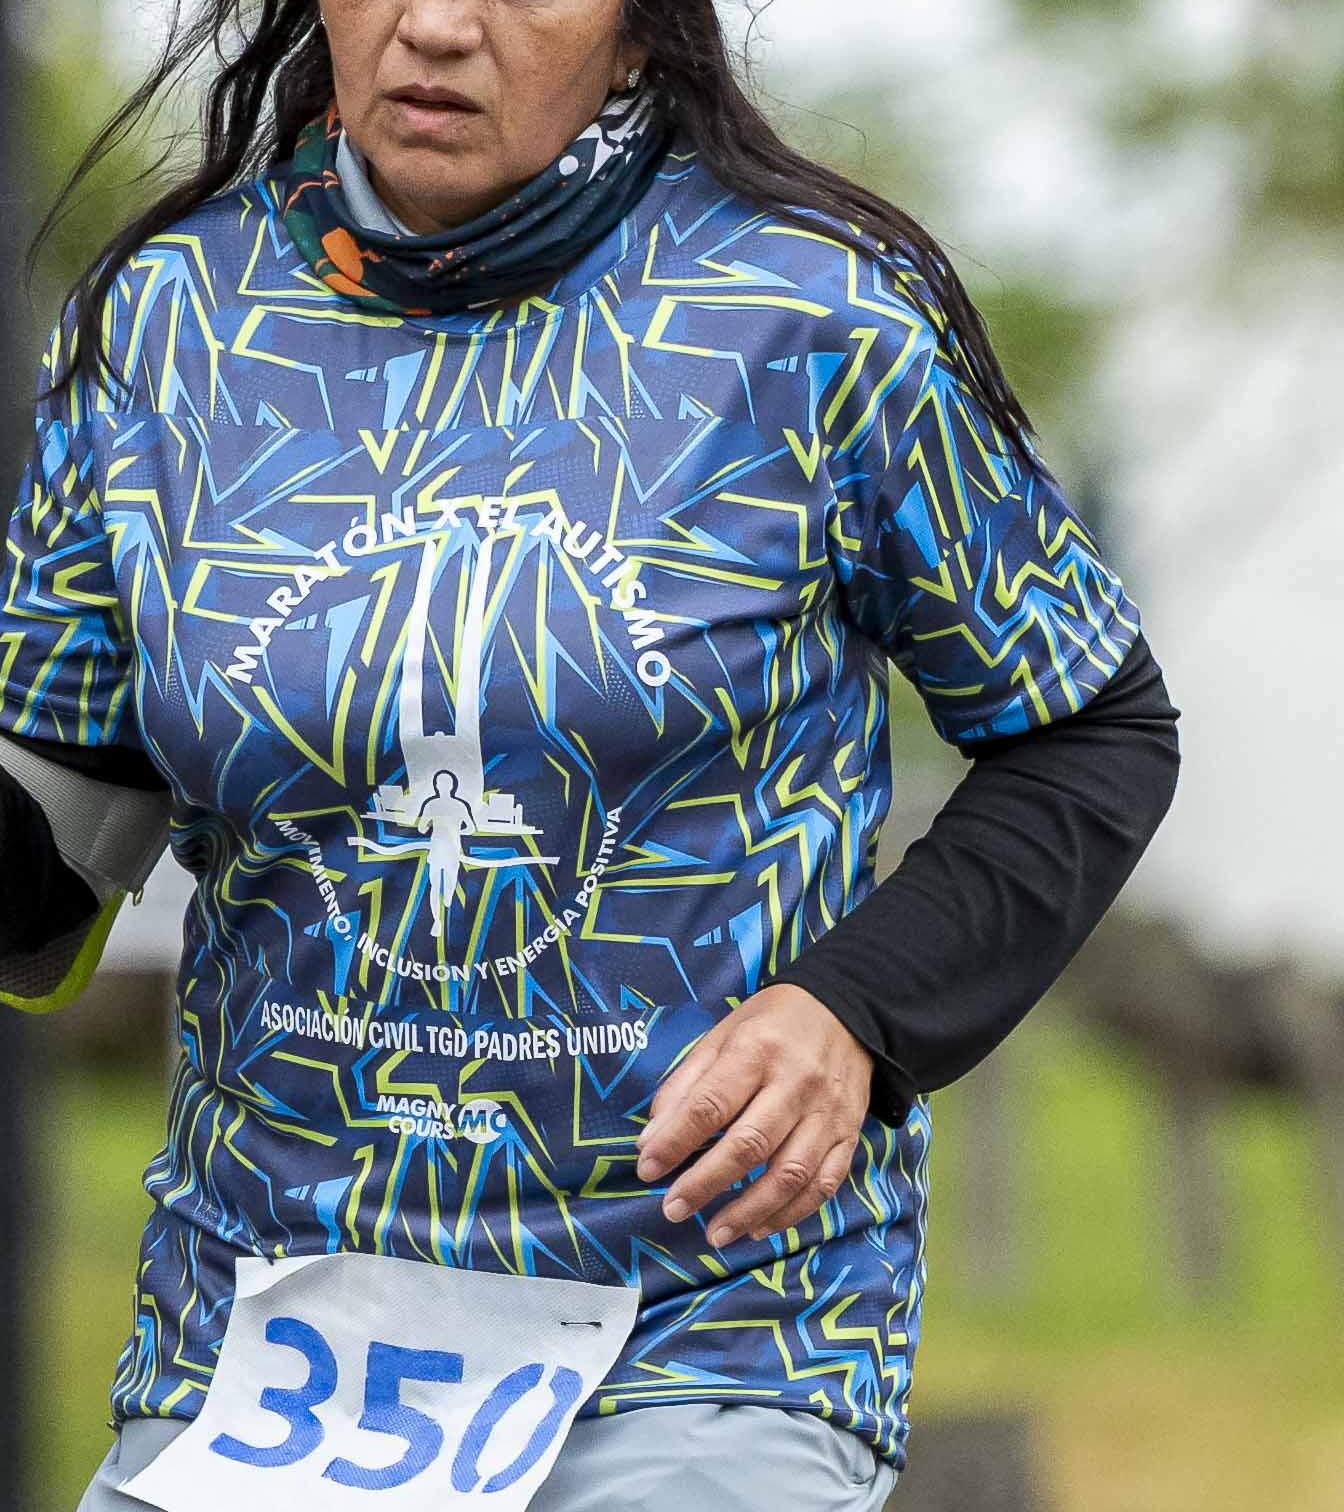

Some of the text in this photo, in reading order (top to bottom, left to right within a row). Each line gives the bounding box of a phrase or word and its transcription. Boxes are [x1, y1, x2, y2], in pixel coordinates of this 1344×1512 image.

[226, 496, 672, 688] MARATÓN X EL AUTISMO
[474, 962, 489, 980] Y
[496, 907, 581, 977] ENERGÍA
[574, 806, 623, 909] POSITIVA
[260, 999, 648, 1062] ASOCIACIÓN CIVIL TGD PADRES UNIDOS
[376, 1094, 457, 1122] MAGNY
[388, 1115, 455, 1140] COURS
[209, 1316, 584, 1494] 350
